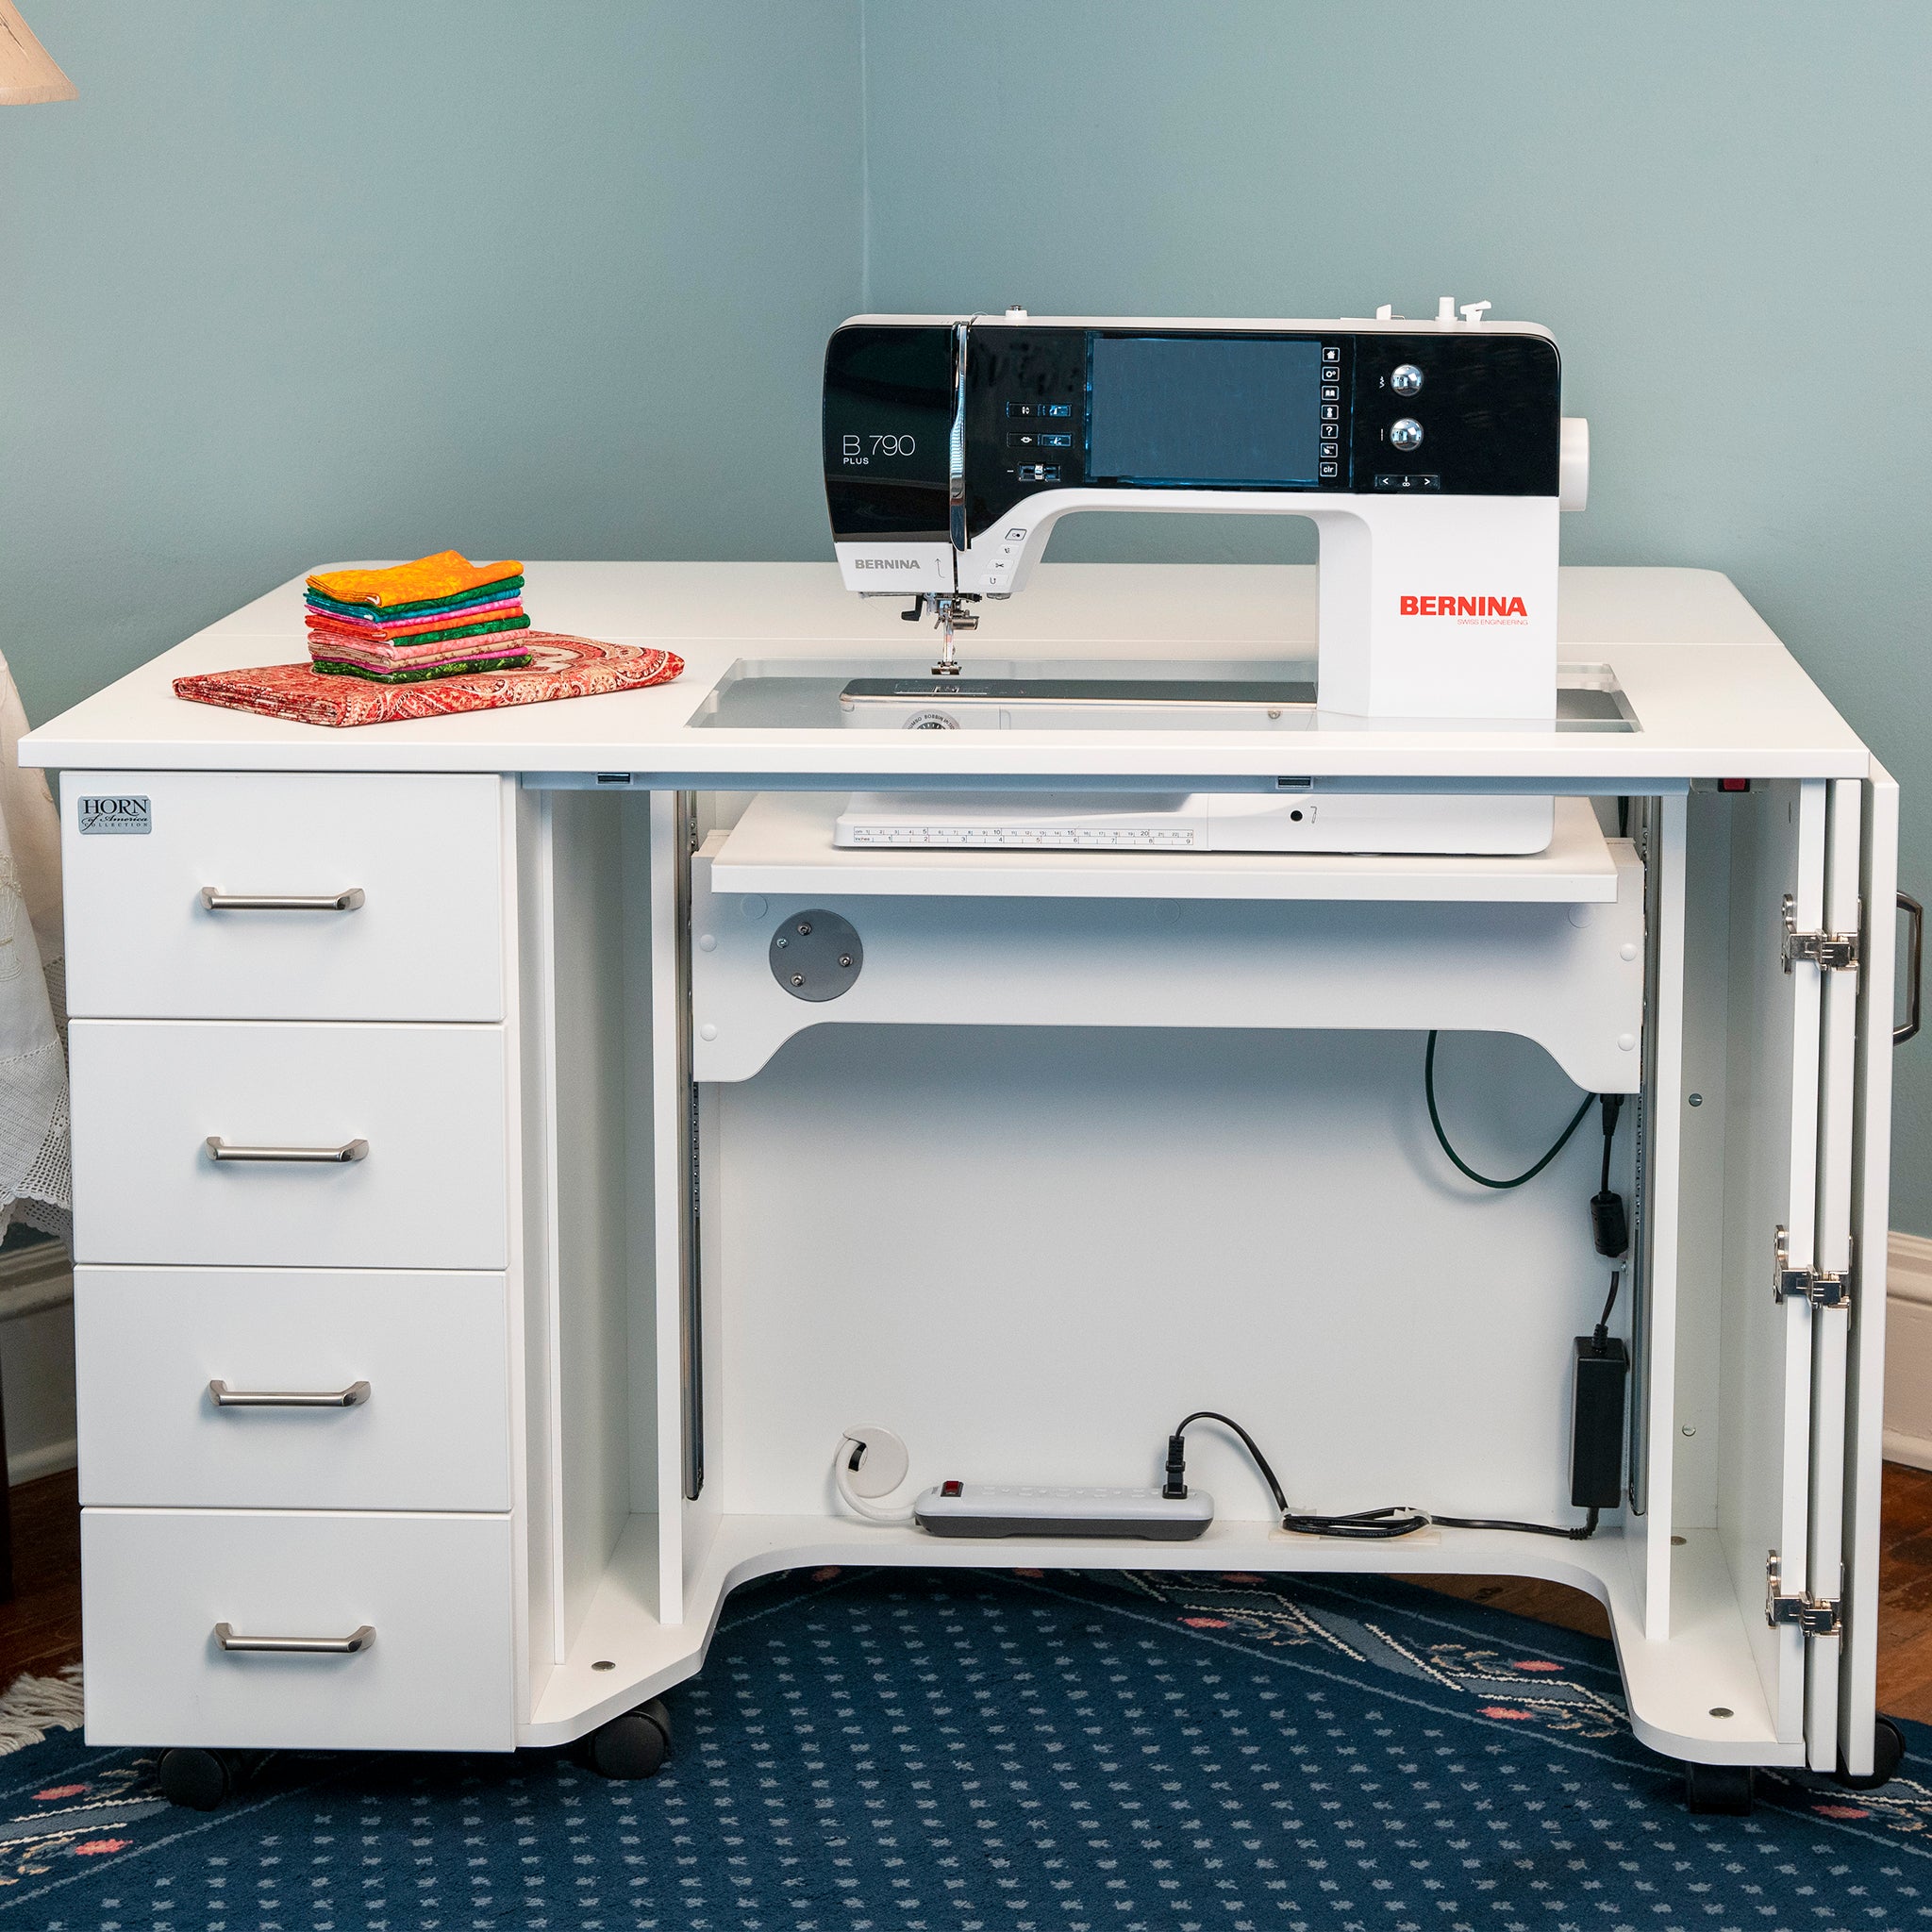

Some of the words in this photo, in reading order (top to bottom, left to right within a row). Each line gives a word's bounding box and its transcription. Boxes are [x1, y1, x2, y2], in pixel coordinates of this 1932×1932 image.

[842, 435, 860, 456] B
[869, 435, 916, 456] 790
[855, 559, 921, 570] BERNINA
[1400, 596, 1528, 617] BERNINA
[83, 799, 148, 816] HORN
[81, 812, 103, 832] of
